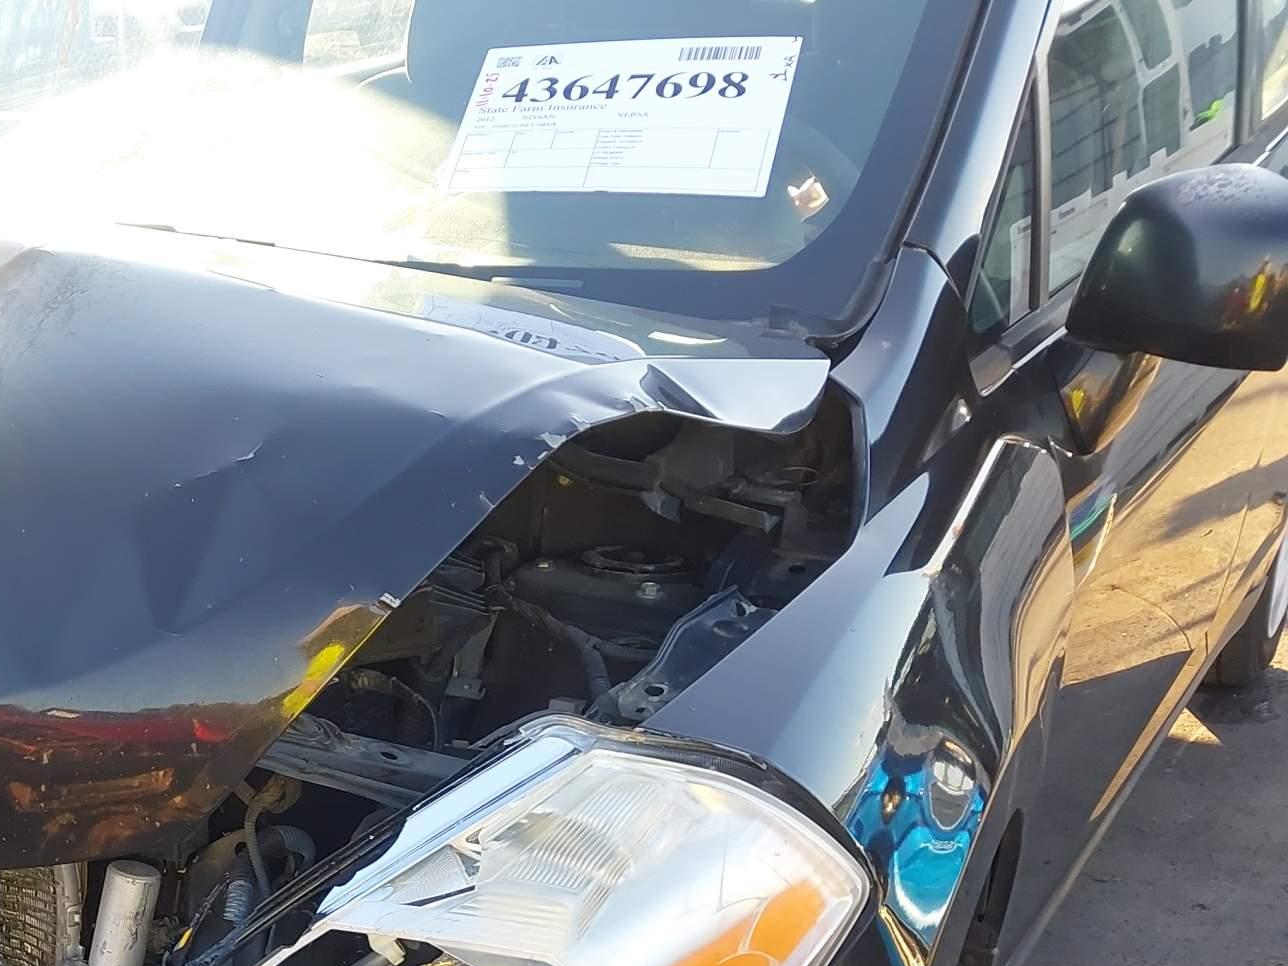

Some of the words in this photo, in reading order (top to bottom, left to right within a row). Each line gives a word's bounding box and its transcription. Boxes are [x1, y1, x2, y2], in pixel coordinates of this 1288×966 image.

[502, 71, 749, 102] 43647698
[477, 106, 509, 114] State
[512, 104, 544, 113] Farm
[548, 103, 608, 111] Insurance
